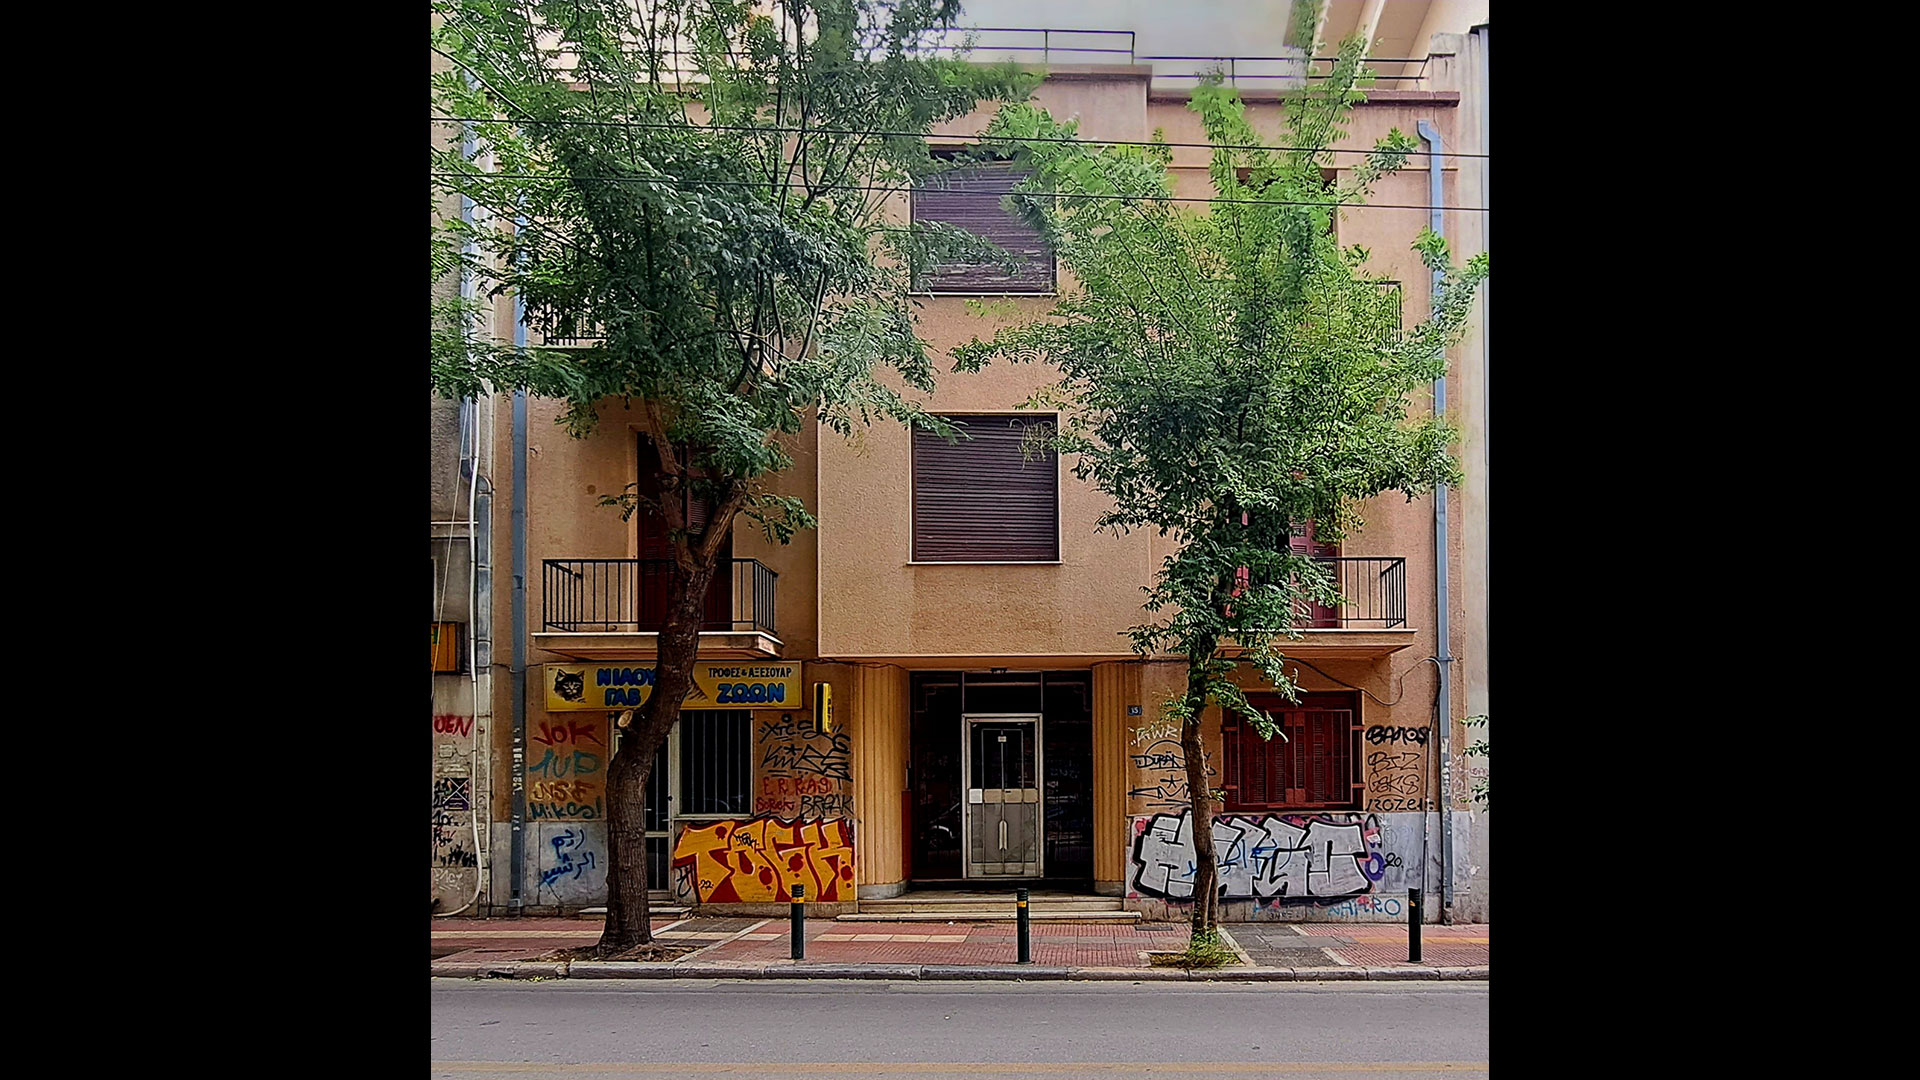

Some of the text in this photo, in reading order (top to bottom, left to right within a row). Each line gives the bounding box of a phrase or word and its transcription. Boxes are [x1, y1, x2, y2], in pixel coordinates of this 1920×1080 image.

[708, 667, 741, 678] ΤΡΟΦΕΣ
[748, 667, 792, 678] ΑΞΕΣΟΥΑΡ
[604, 687, 642, 706] ΓΑΒ
[716, 682, 785, 703] ΖΩΩΝ
